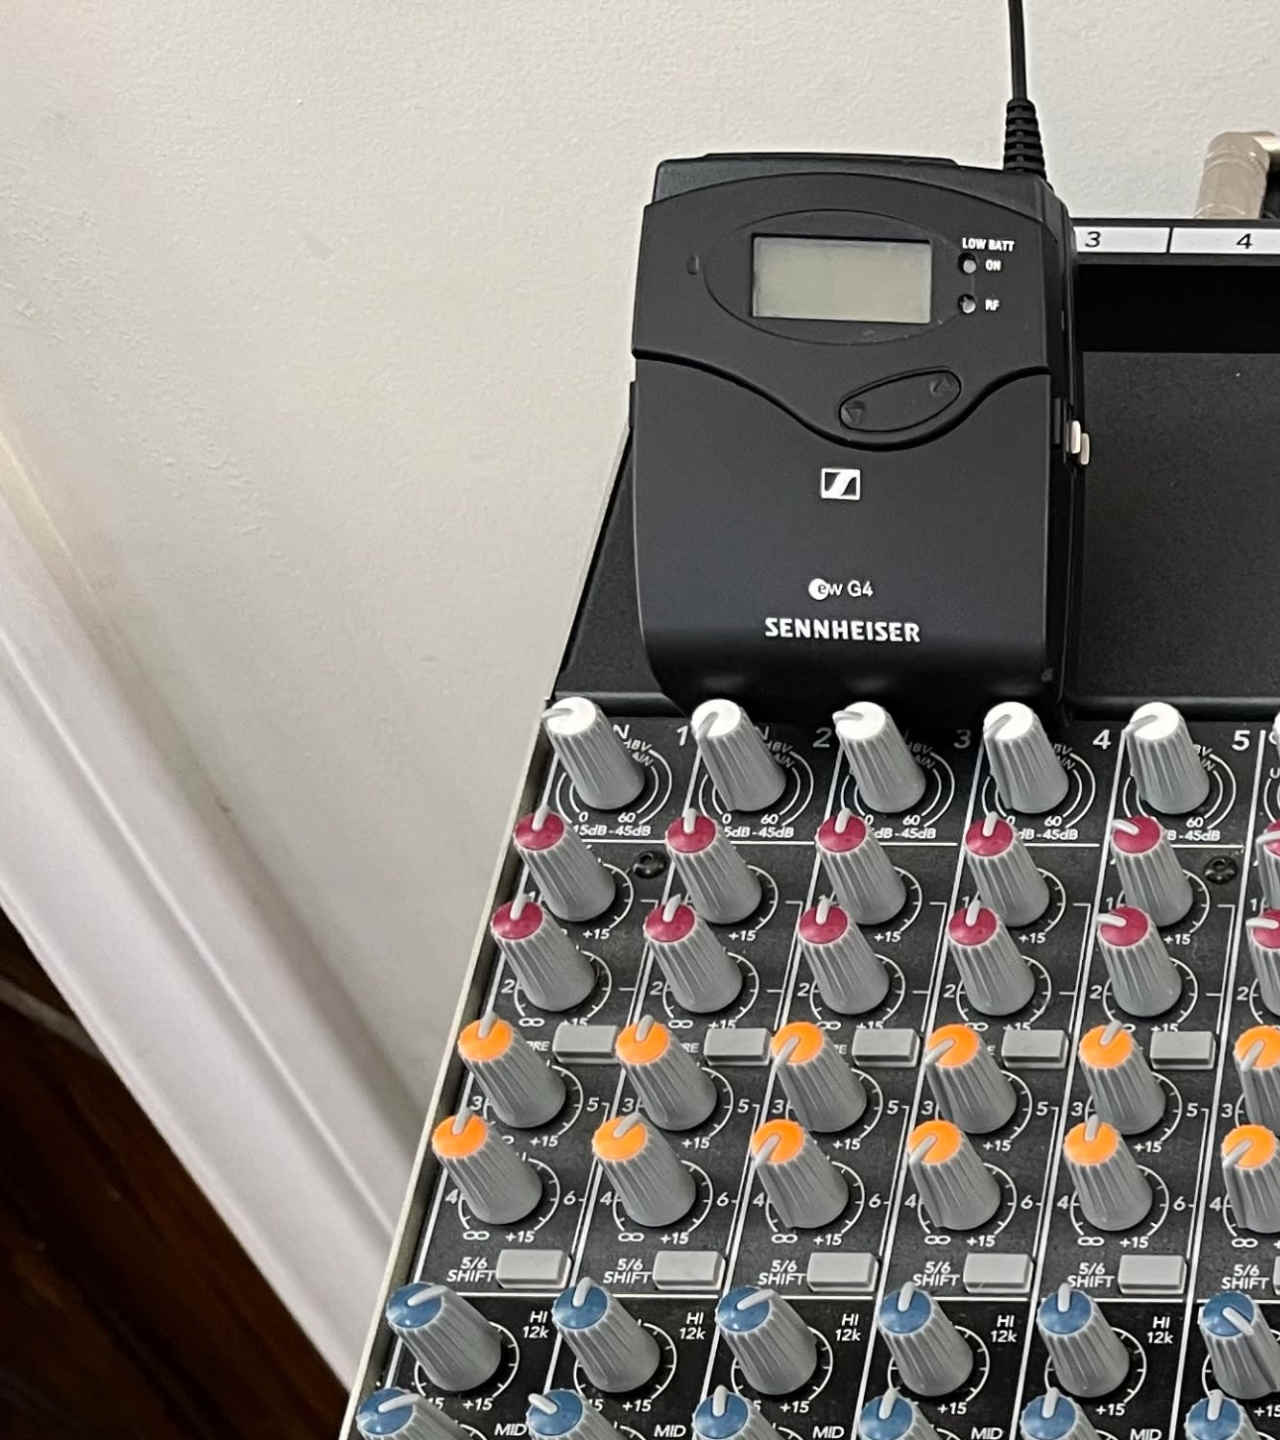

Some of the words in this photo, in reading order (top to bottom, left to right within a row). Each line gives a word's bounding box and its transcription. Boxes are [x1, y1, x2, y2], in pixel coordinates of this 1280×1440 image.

[963, 238, 986, 249] LOW
[989, 240, 1014, 251] BATT
[1085, 231, 1100, 247] 3
[1237, 234, 1252, 249] 4
[986, 260, 1000, 270] ON
[986, 300, 998, 310] RF
[847, 580, 873, 596] G4
[765, 618, 920, 642] SENNHEISER
[617, 1259, 643, 1270] 5/6
[603, 1271, 651, 1283] SHIFT
[842, 1314, 858, 1326] HI
[836, 1329, 860, 1341] 12k
[813, 1426, 844, 1438] MID
